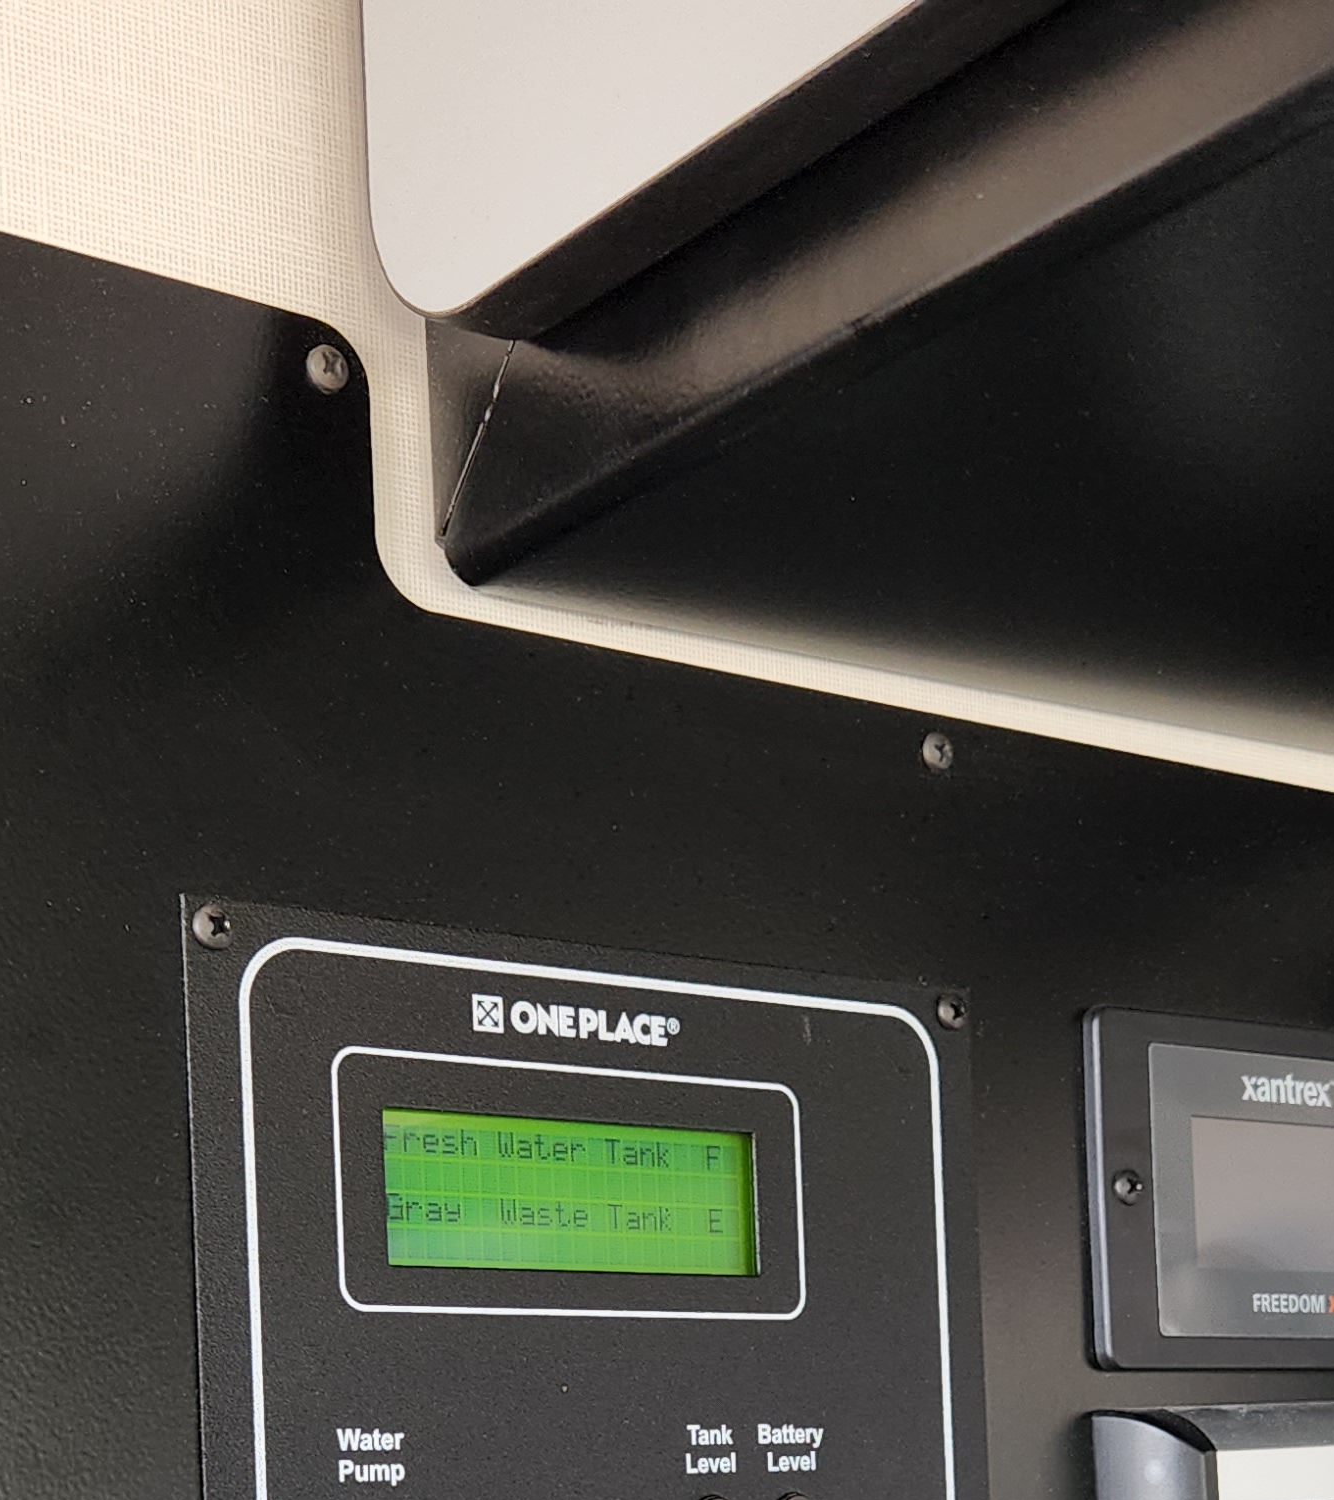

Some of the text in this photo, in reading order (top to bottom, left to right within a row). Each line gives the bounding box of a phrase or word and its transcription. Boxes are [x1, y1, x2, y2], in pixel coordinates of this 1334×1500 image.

[384, 1125, 721, 1170] Fresh Water Tank F
[387, 1193, 723, 1233] Gray Waste Tank E
[1252, 1293, 1326, 1314] FREEDOM
[336, 1428, 405, 1452] Water
[686, 1424, 733, 1446] Tank
[757, 1423, 823, 1449] Battery
[338, 1459, 406, 1486] Pump
[685, 1452, 737, 1474] Level
[767, 1451, 817, 1473] Level
